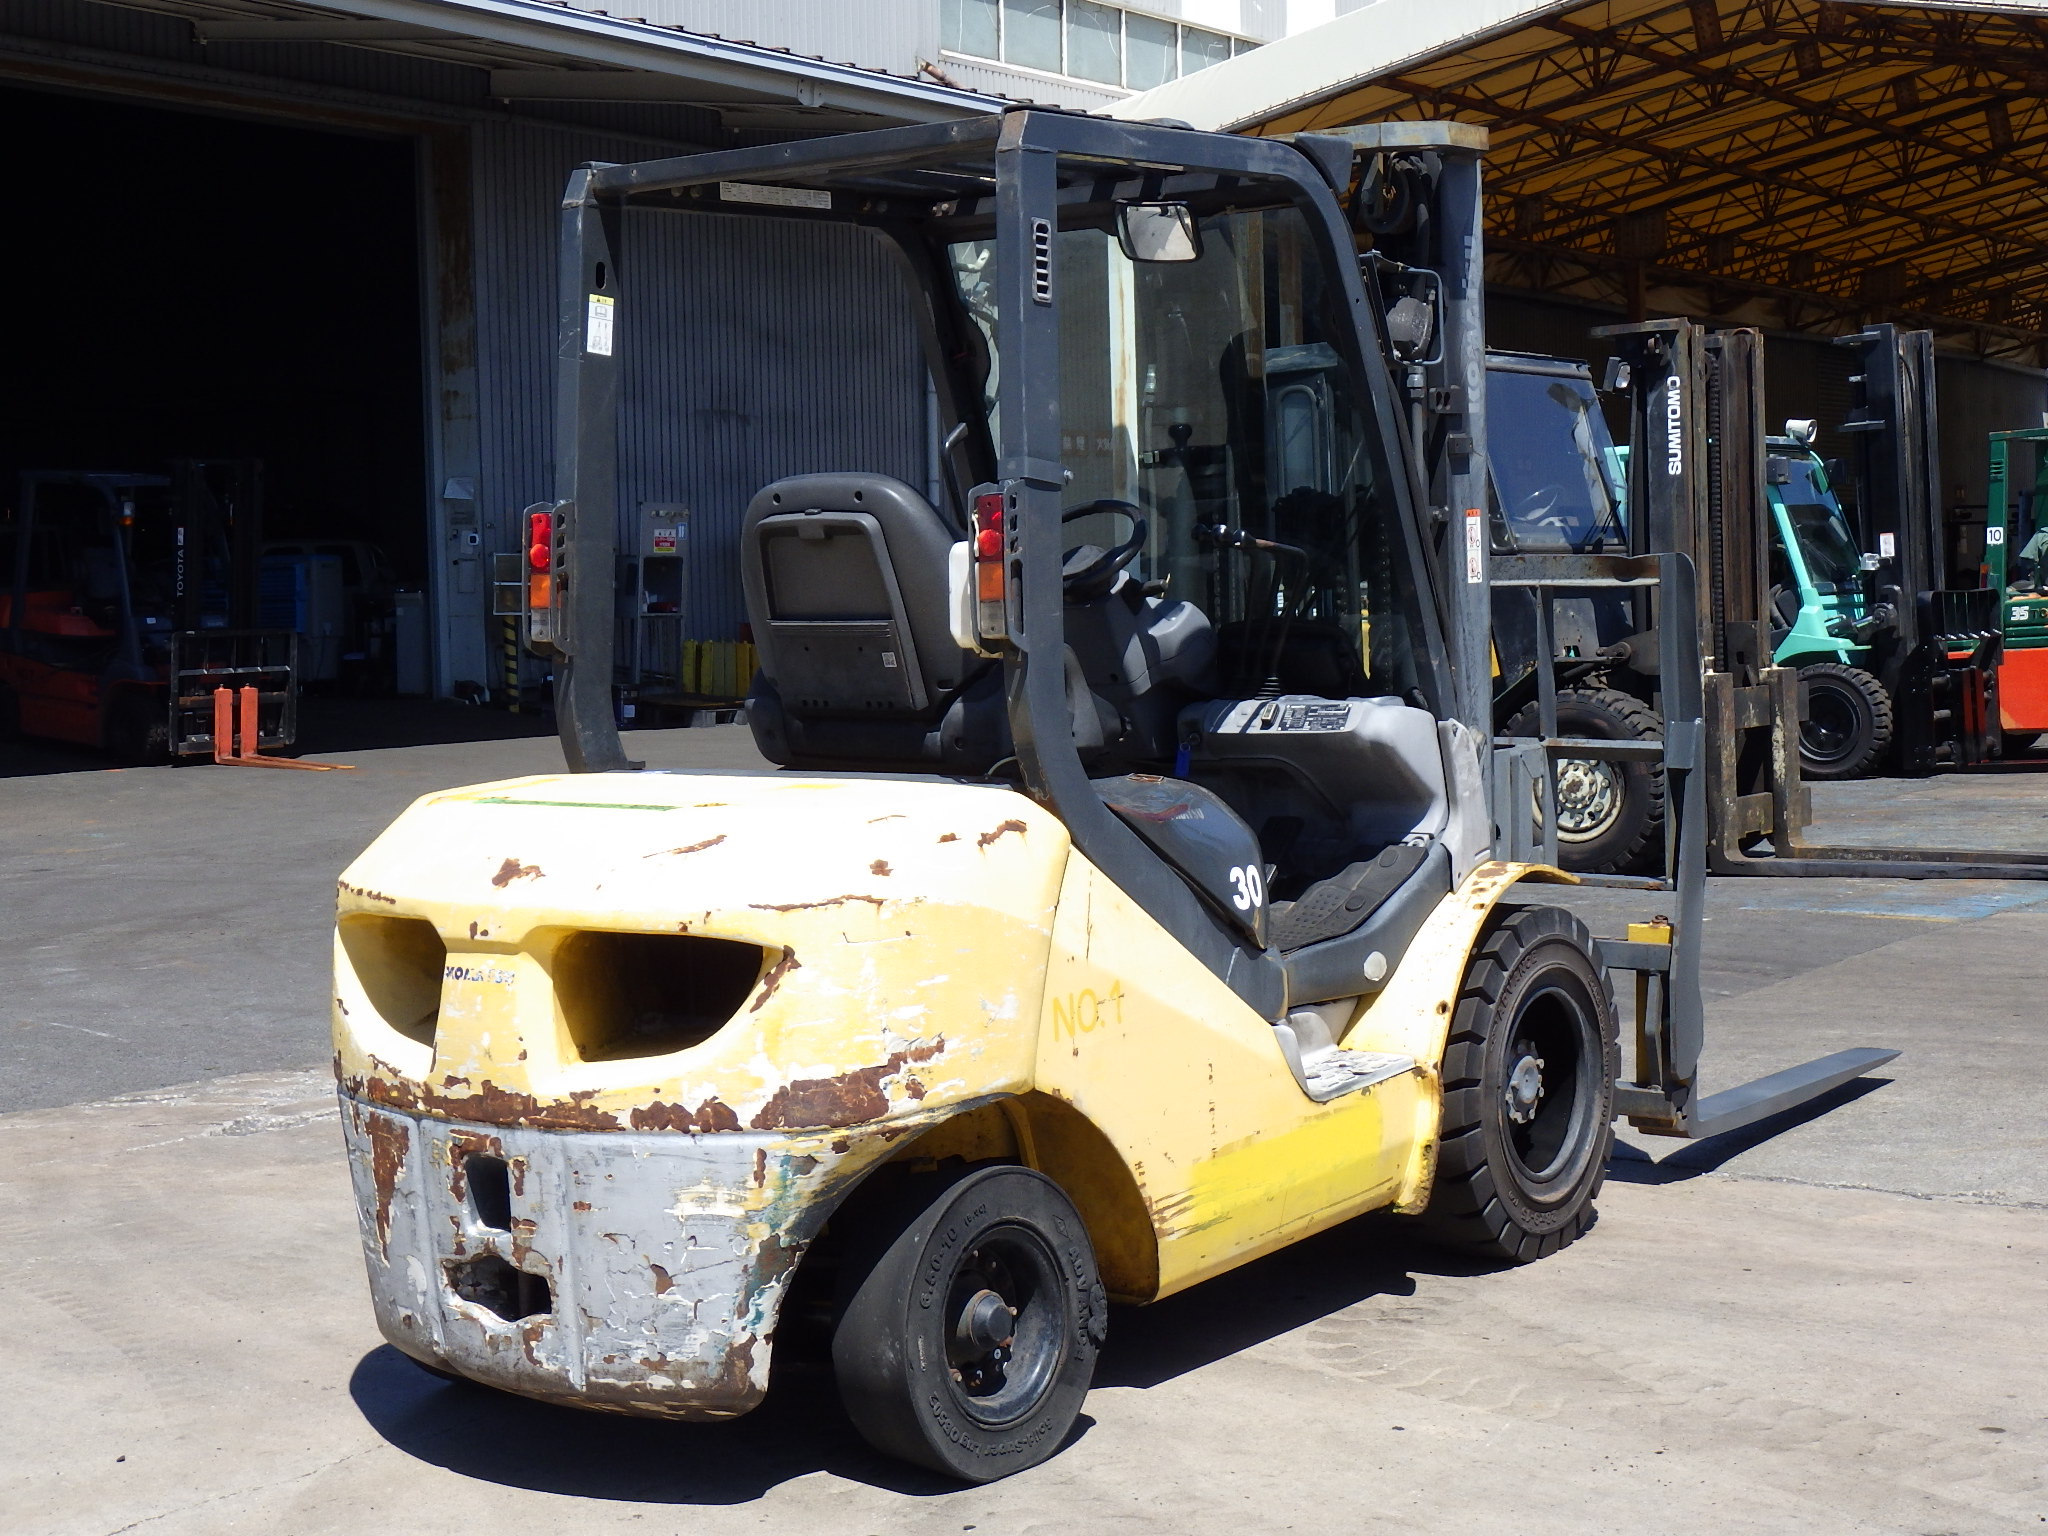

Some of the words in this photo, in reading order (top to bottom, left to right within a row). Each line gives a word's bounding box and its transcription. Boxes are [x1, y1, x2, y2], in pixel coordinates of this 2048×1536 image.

[1463, 236, 1480, 413] KOMAT
[1667, 375, 1682, 476] SUMITOMO
[1989, 529, 2002, 542] 10
[176, 549, 184, 597] TOYOTA
[2010, 605, 2030, 621] 35
[1229, 864, 1263, 911] 30
[445, 966, 515, 984] KOASU
